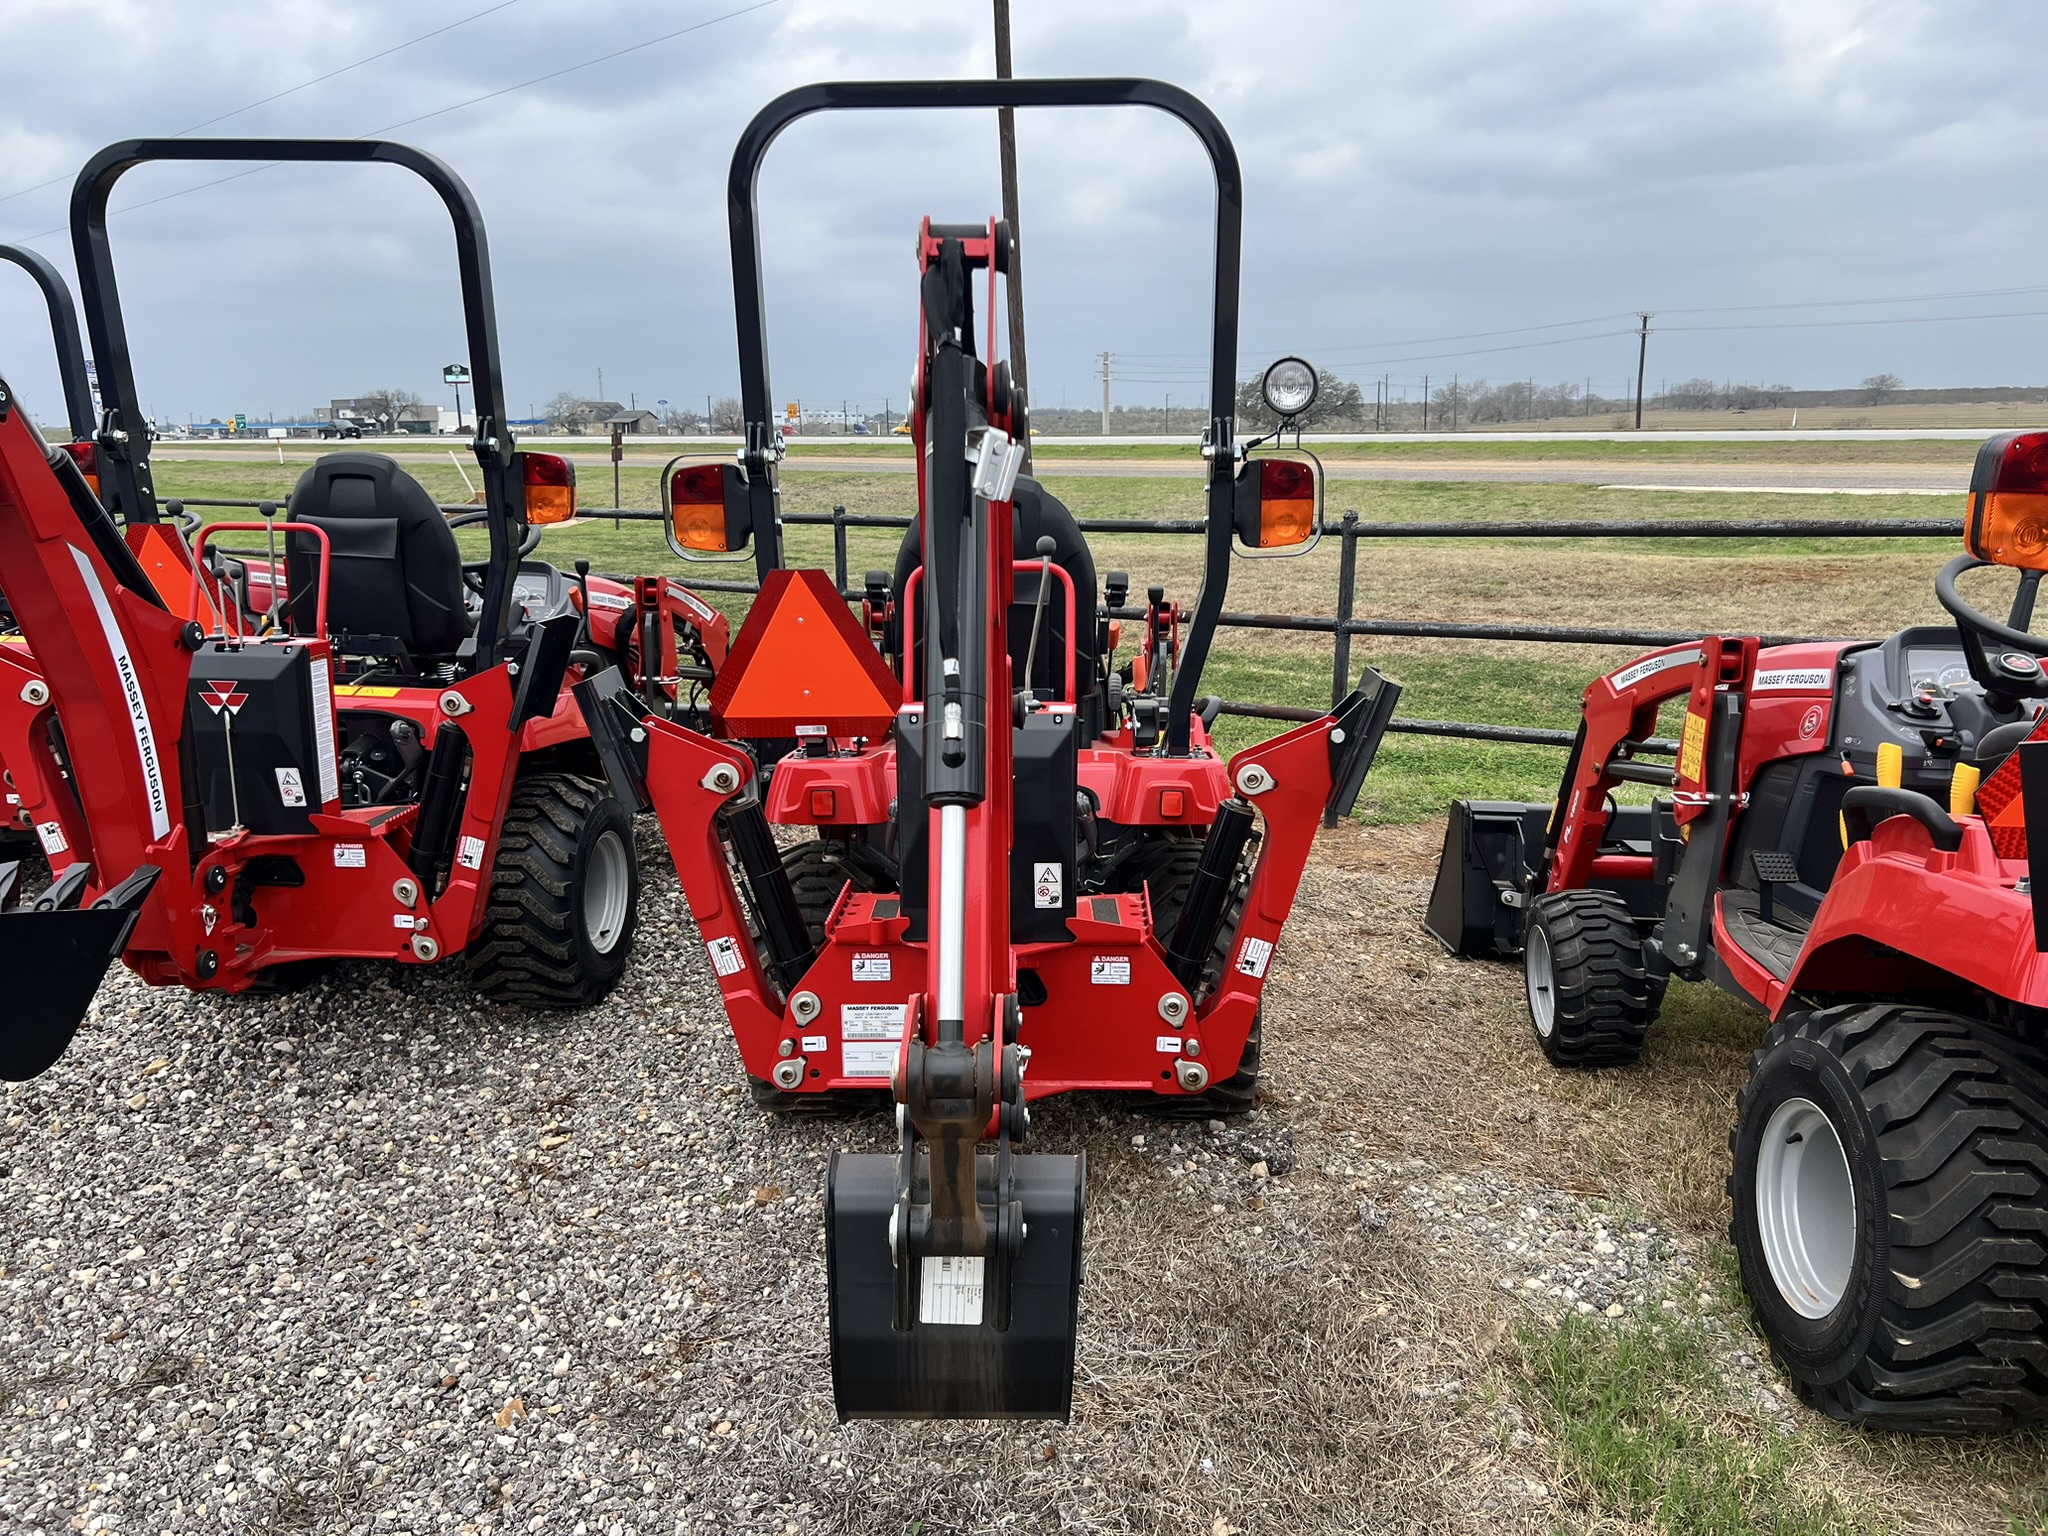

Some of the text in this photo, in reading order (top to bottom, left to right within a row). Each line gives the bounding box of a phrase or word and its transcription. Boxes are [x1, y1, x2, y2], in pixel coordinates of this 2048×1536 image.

[1620, 658, 1666, 684] MASSEY FERGUSON
[1758, 674, 1827, 686] MASSEY FERGUSON
[118, 655, 163, 813] MASSEY FERGUSON
[731, 943, 747, 970] DANGER
[1236, 936, 1251, 962] DANGER
